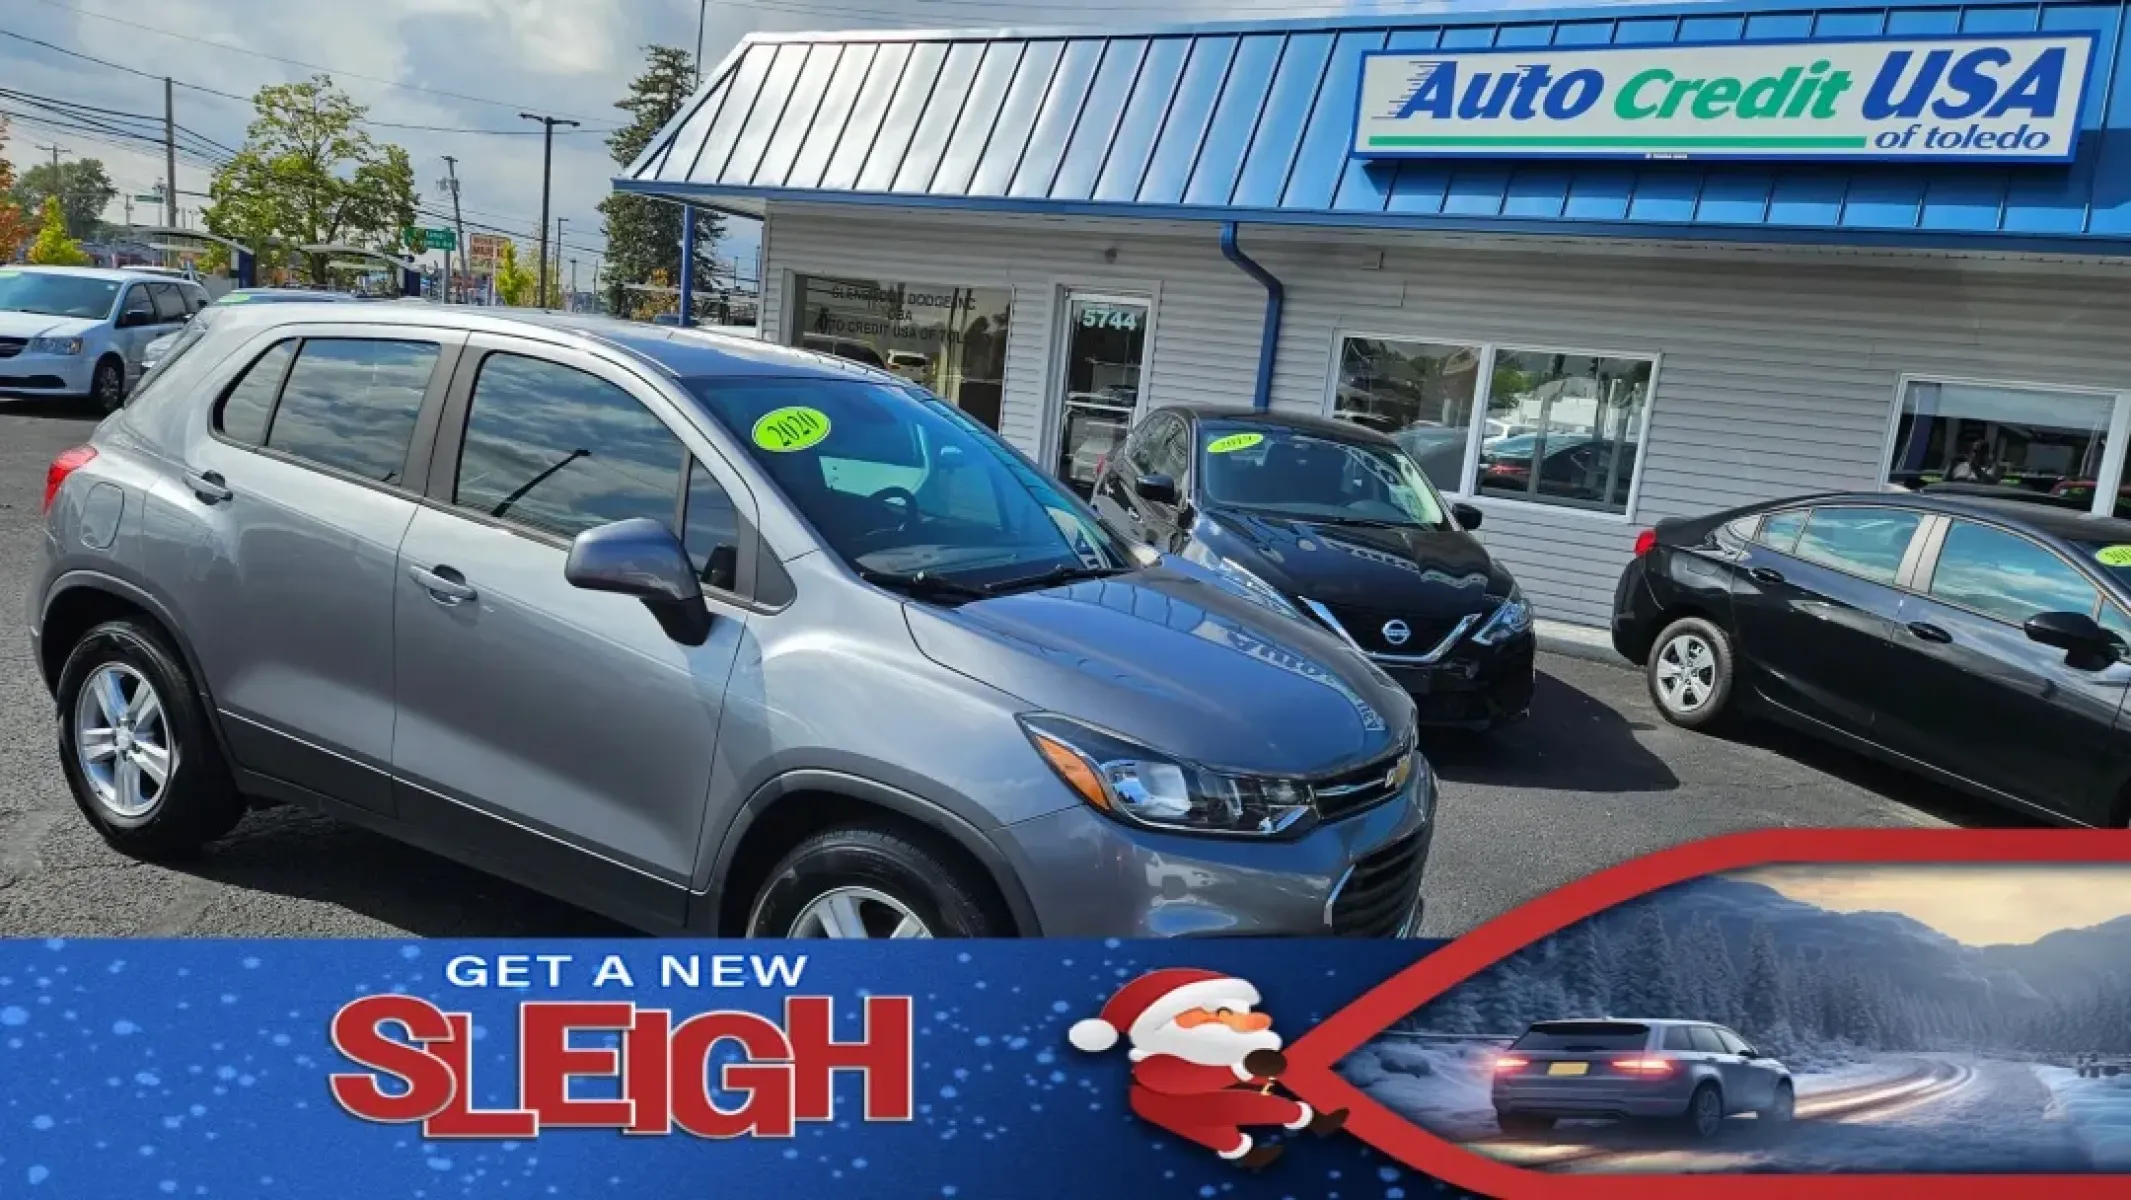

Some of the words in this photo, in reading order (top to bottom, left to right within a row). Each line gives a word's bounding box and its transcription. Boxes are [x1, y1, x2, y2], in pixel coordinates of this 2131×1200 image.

[1394, 60, 1605, 121] Auto
[1613, 60, 1852, 120] Credit
[1862, 47, 2067, 120] USA
[1874, 125, 1922, 149] of
[1924, 125, 2051, 149] toledo
[908, 292, 952, 308] DODGE
[847, 320, 889, 337] CREDIT
[893, 326, 917, 339] USA
[920, 328, 938, 341] OF
[1082, 309, 1138, 331] 5744
[766, 410, 820, 447] 2020
